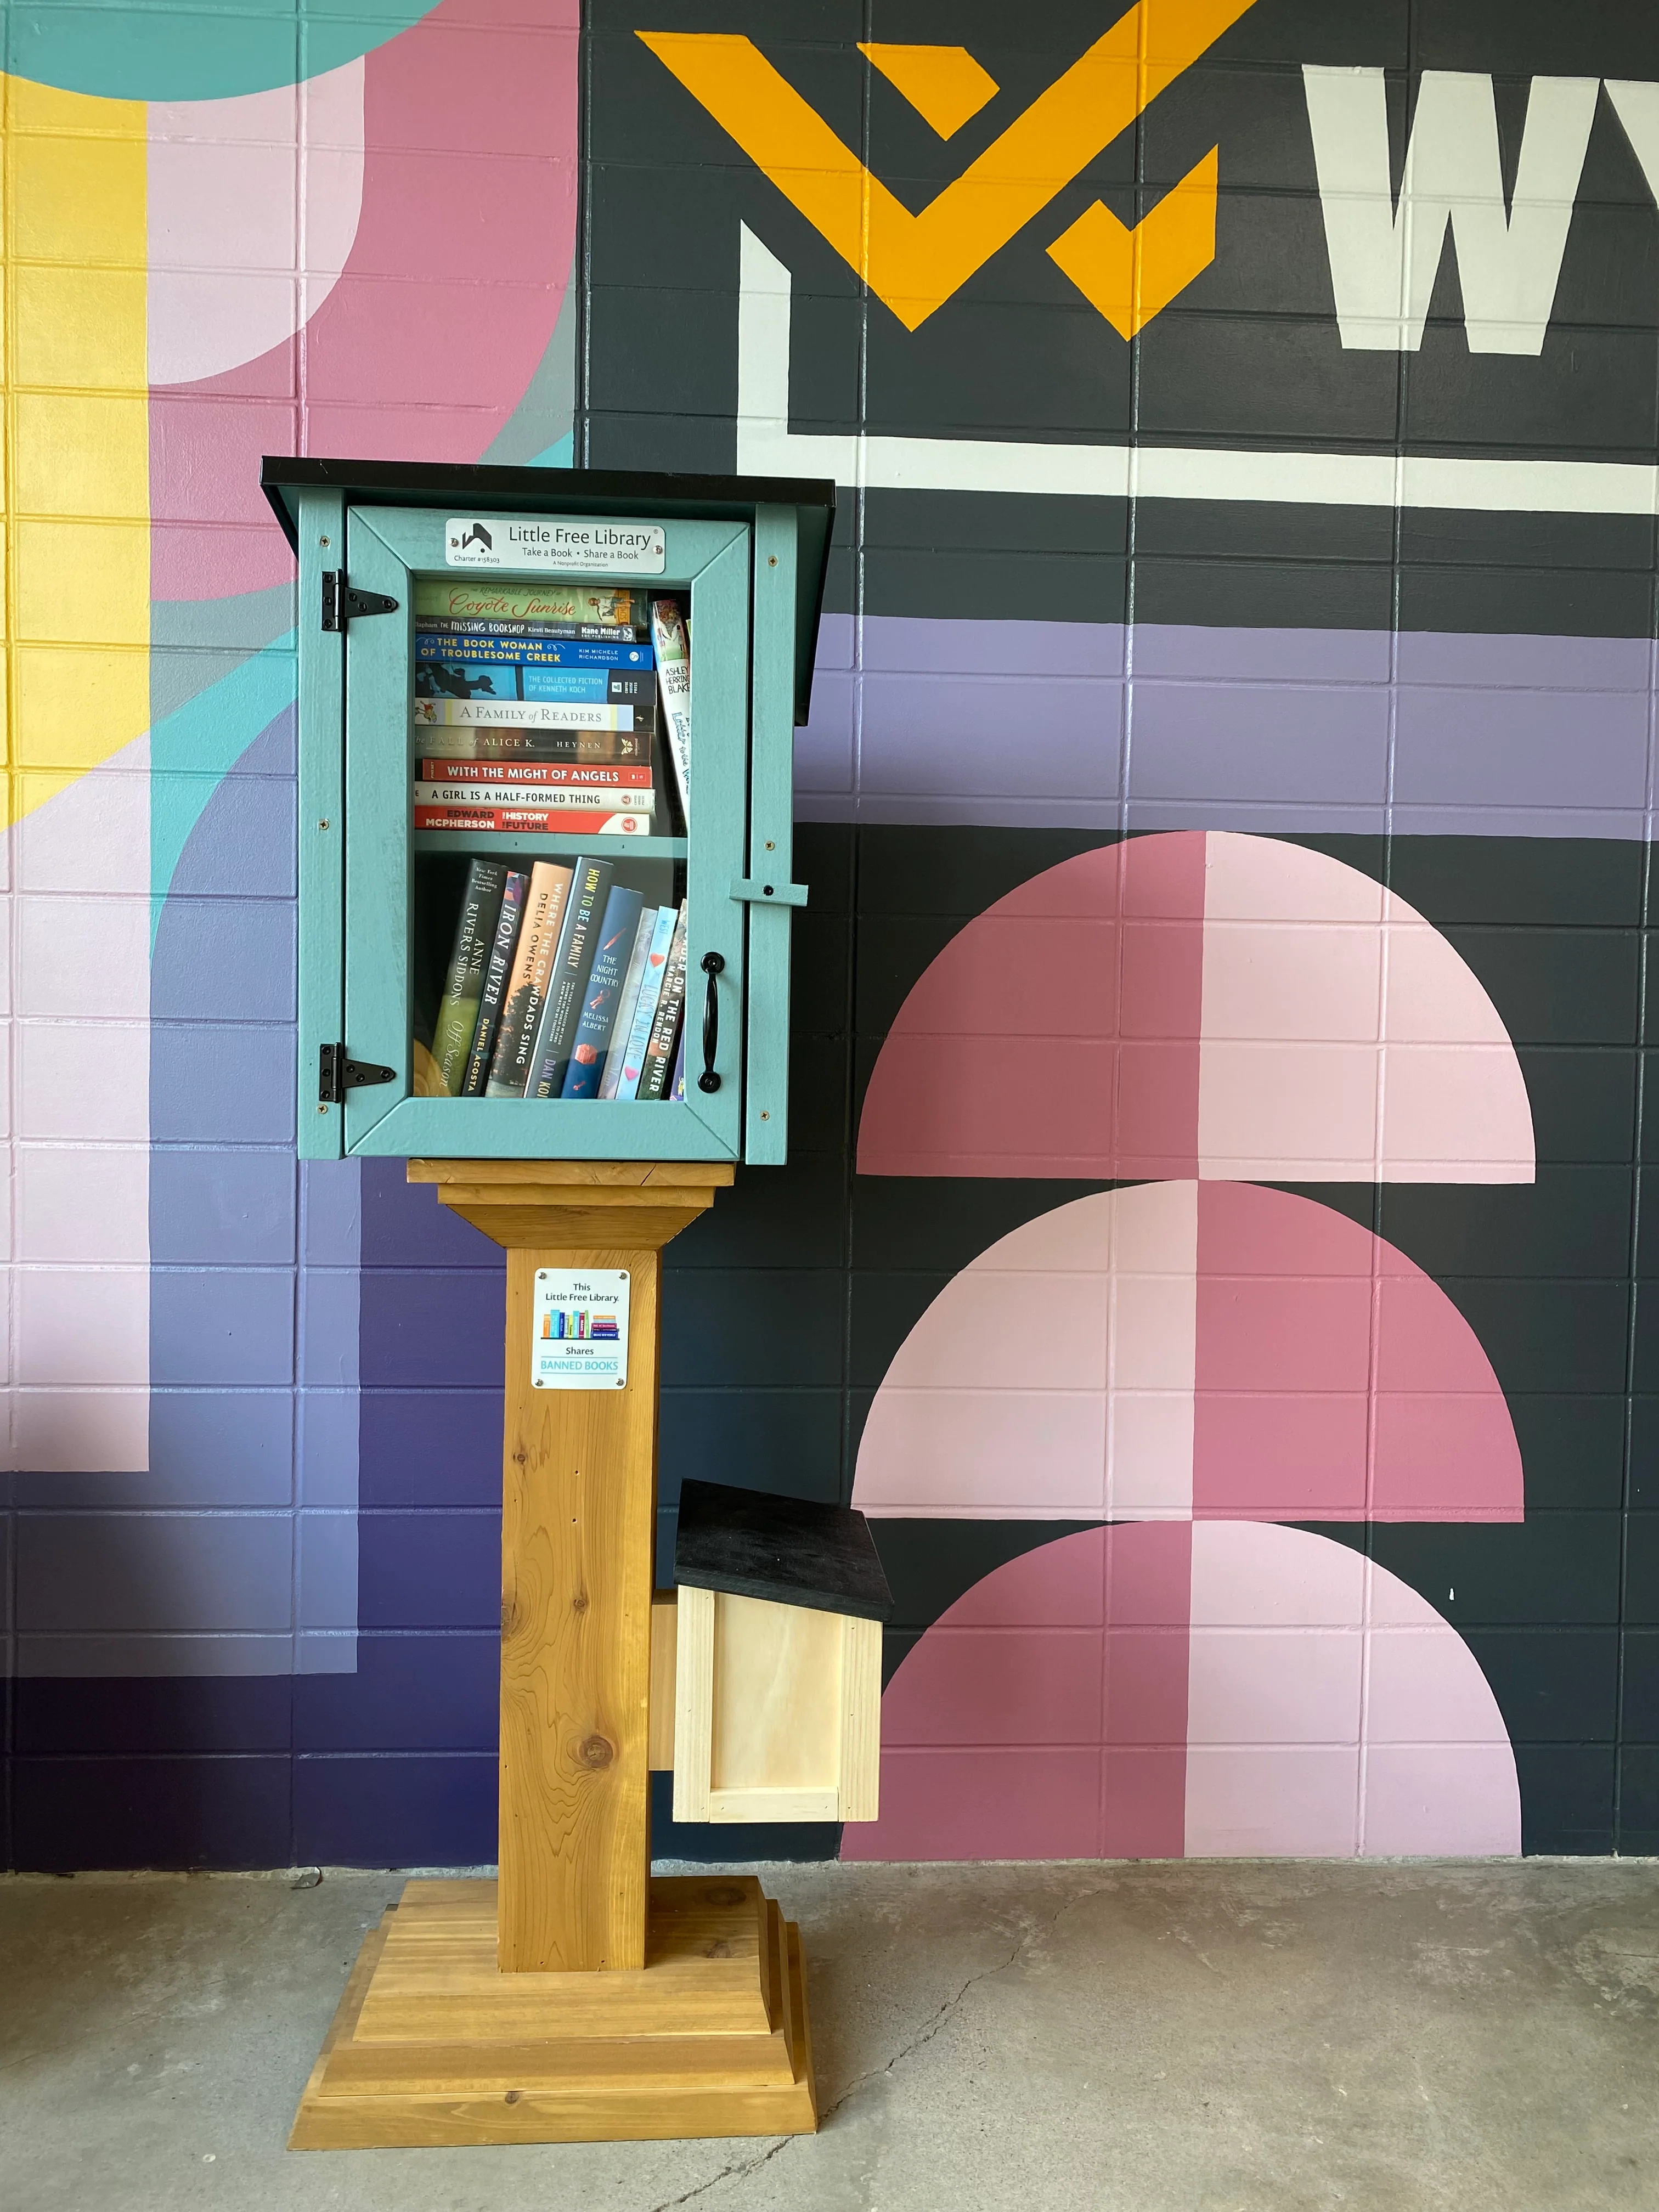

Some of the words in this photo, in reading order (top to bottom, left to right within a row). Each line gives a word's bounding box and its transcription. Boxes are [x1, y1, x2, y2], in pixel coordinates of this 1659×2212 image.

[509, 526, 550, 542] Little
[556, 528, 590, 544] Free
[595, 529, 651, 550] Library
[522, 548, 541, 556] Take
[551, 549, 572, 557] Book
[584, 550, 608, 558] Share
[617, 551, 639, 560] Book
[480, 587, 522, 596] REMARKABLE
[449, 588, 509, 615] Coyote
[512, 598, 576, 618] Sunrise
[489, 623, 524, 634] BOOKSHOP
[437, 638, 458, 646] THE
[464, 639, 495, 648] BOOK
[500, 641, 542, 650] WOMAN
[441, 649, 520, 660] TROUBLESOME
[527, 653, 561, 662] CREEK
[665, 666, 689, 676] ASHLEY
[459, 706, 472, 718] A
[476, 707, 526, 719] FAMILY
[528, 711, 538, 723] of
[541, 708, 601, 722] READERS
[430, 737, 464, 745] FALL
[469, 738, 478, 748] of
[483, 738, 520, 747] ALICE
[526, 739, 535, 747] K.
[679, 746, 686, 754] to
[447, 766, 478, 777] WITH
[482, 767, 504, 777] THE
[507, 768, 548, 780] MIGHT
[551, 770, 567, 780] OF
[571, 771, 619, 782] ANGELS
[432, 790, 438, 798] A
[443, 790, 466, 799] GIRL
[470, 791, 480, 800] IS
[484, 792, 491, 800] A
[495, 792, 565, 803] HALF-FORMED
[569, 794, 600, 804] THING
[447, 810, 494, 819] EDWARD
[506, 812, 549, 821] HISTORY
[426, 819, 494, 828] MCPHERSON
[506, 821, 549, 830] FUTURE
[471, 878, 498, 889] Bestselling
[584, 868, 600, 893] HOW
[546, 883, 563, 927] WHERE
[582, 895, 594, 907] TO
[533, 893, 548, 929] DELIA
[578, 909, 591, 922] BE
[460, 902, 479, 951] RIVERS
[497, 904, 517, 950] IRON
[659, 920, 670, 934] WEST
[540, 932, 553, 956] THE
[567, 933, 585, 968] FAMILY
[469, 938, 485, 975] ANNE
[523, 935, 539, 979] OWENS
[603, 955, 617, 965] THE
[596, 964, 618, 976] NIGHT
[450, 956, 469, 1006] SIDDONS
[484, 955, 505, 1005] RIVER
[590, 974, 620, 988] COUNTRY
[663, 965, 676, 996] MARCIE
[672, 977, 684, 994] ON
[524, 960, 546, 1030] CRAWDADS
[636, 984, 658, 1018] LUCKY
[660, 1000, 668, 1008] R.
[665, 1000, 679, 1022] THE
[583, 1011, 609, 1023] MELISSA
[446, 1020, 465, 1045] Off
[582, 1021, 606, 1031] ALBERT
[633, 1019, 651, 1033] IN
[651, 1011, 662, 1043] RENDON
[477, 1018, 490, 1052] DANIEL
[659, 1027, 673, 1051] RED
[516, 1034, 531, 1064] SING
[627, 1035, 646, 1060] LOVE
[439, 1043, 460, 1087] Season
[468, 1054, 481, 1091] ACOSTA
[541, 1058, 556, 1080] DAN
[649, 1056, 666, 1092] RIVER
[573, 1283, 591, 1291] This
[590, 1293, 618, 1304] Library
[566, 1347, 594, 1355] Shares
[541, 1361, 582, 1369] BANNED
[585, 1361, 618, 1370] BOOKS
